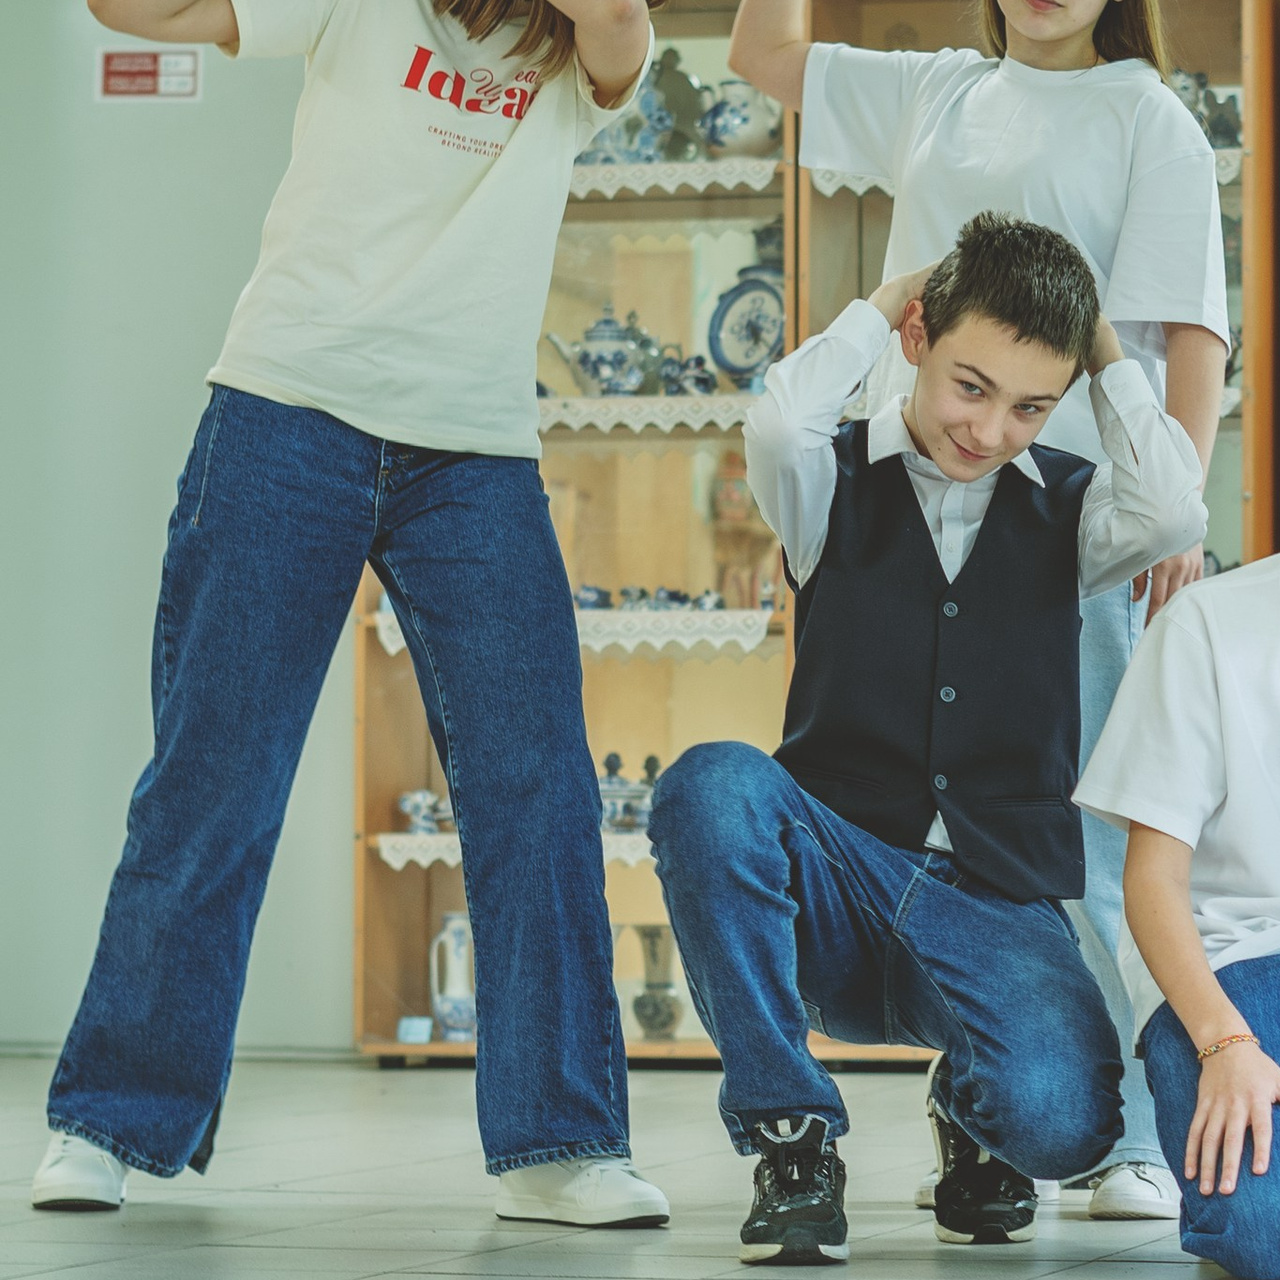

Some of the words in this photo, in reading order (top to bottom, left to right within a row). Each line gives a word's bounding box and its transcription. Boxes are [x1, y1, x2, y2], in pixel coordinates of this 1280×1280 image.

[428, 125, 467, 143] CRAFTING
[470, 138, 487, 148] YOUR
[489, 141, 503, 151] DRE
[441, 139, 472, 153] BEYOND
